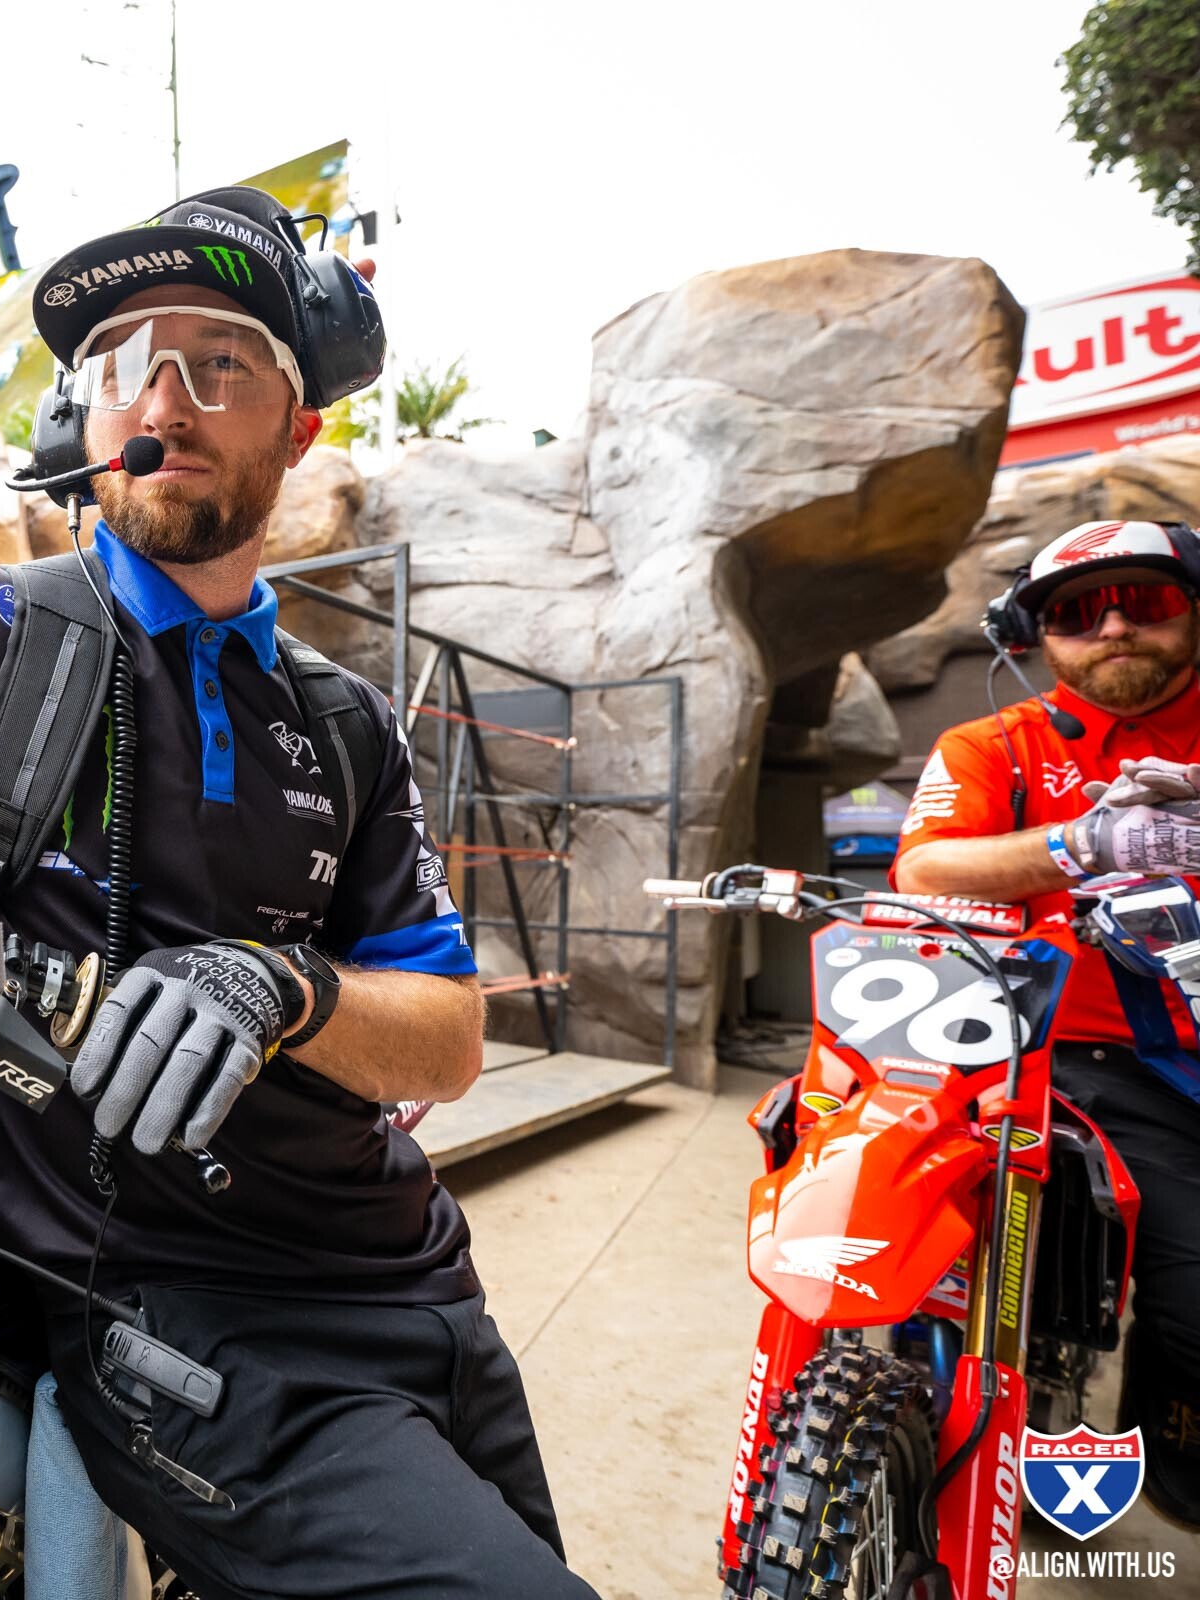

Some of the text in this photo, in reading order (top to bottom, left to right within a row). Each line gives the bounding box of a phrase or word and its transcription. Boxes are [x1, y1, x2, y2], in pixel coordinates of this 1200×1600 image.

[71, 249, 194, 289] YAMAHA
[214, 218, 283, 269] YAMAHA
[1014, 305, 1200, 387] ult
[871, 904, 1013, 925] RENTHAL
[830, 959, 1033, 1066] 96
[772, 1260, 880, 1301] HONDA
[730, 1346, 769, 1525] DUNLOP
